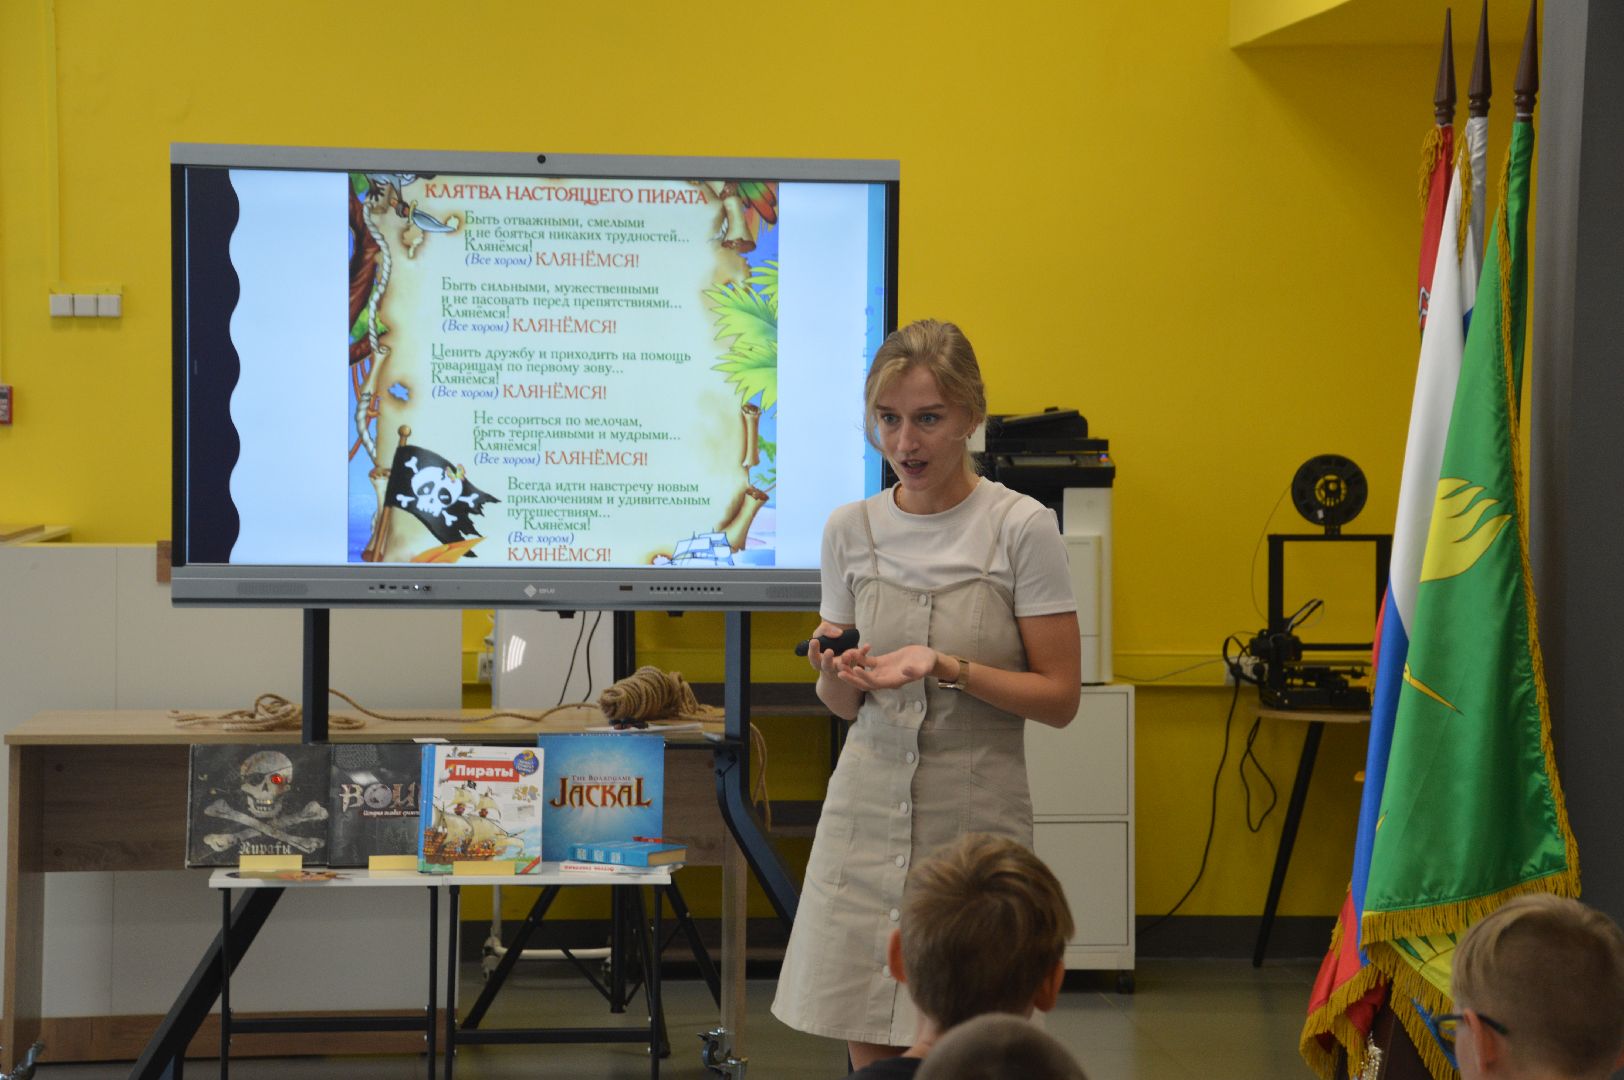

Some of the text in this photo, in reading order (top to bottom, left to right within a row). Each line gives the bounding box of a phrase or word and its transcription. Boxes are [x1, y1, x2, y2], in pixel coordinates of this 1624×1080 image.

[425, 183, 709, 206] КЛЯТВА НАСТОЯЩЕГО ПИРАТА
[464, 210, 645, 228] Быть отважными, смелыми
[464, 229, 472, 238] и
[479, 230, 492, 239] не
[494, 226, 545, 239] бояться
[549, 230, 601, 241] никаких
[464, 237, 533, 253] Клянёмся!
[464, 250, 640, 268] (Все хором) КЛЯНЁМСЯ!
[442, 276, 659, 295] Быть сильными, мужественными
[441, 295, 449, 304] и
[453, 296, 468, 304] не
[472, 296, 529, 306] пасовать
[533, 297, 570, 309] перед
[442, 304, 510, 319] Клянёмся!
[442, 316, 617, 334] (Все хором) КЛЯНЁМСЯ!
[432, 343, 692, 364] Ценить дружбу и приходить на помощь
[431, 361, 502, 374] товарищам
[507, 362, 523, 371] по
[526, 363, 580, 376] первому
[432, 370, 499, 385] Клянёмся!
[432, 382, 607, 400] (Все хором) КЛЯНЁМСЯ!
[474, 410, 642, 428] Не ссориться по мелочам,
[473, 426, 505, 439] быть
[509, 428, 594, 440] терпеливыми
[599, 430, 607, 439] и
[474, 438, 541, 452] Клянёмся!
[474, 448, 648, 467] (Все хором) КЛЯНЁМСЯ!
[507, 476, 699, 494] Всегда идти навстречу новым
[507, 494, 711, 508] приключениям и удивительным
[524, 516, 591, 531] Клянёмся!
[507, 531, 575, 546] (Все хором)
[507, 545, 611, 562] КЛЯНЁМСЯ!
[455, 764, 514, 779] Пираты
[549, 777, 653, 808] JACKAL
